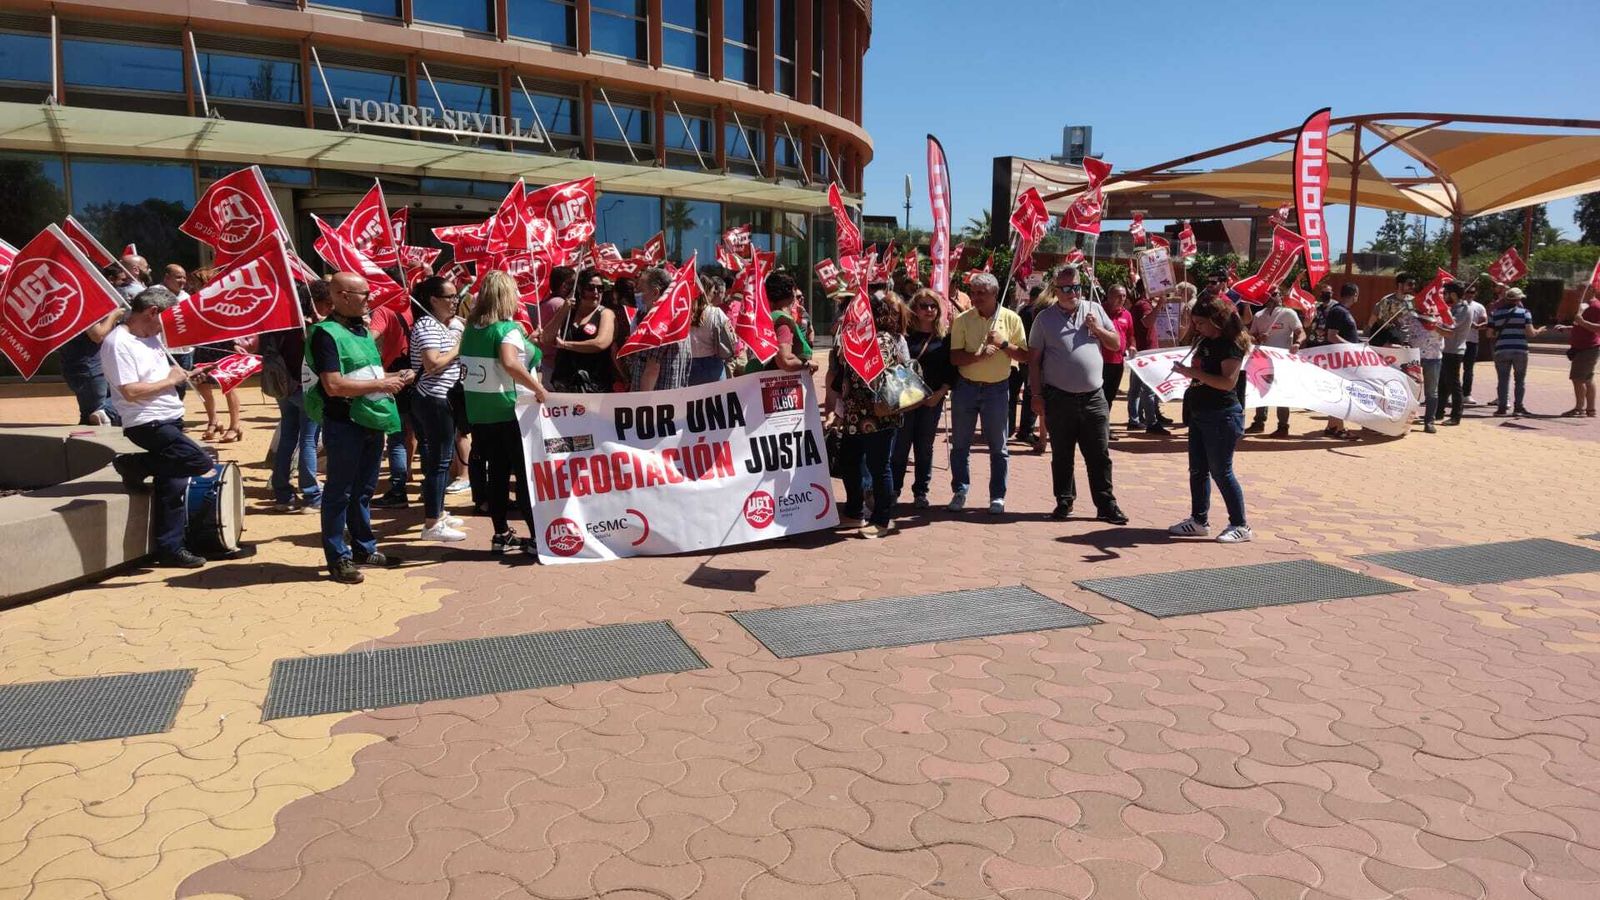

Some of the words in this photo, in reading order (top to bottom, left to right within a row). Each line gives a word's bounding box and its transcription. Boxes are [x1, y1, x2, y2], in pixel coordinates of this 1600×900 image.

[343, 98, 436, 129] TORRE
[440, 109, 543, 141] SEVILLA
[1301, 131, 1322, 236] CCOO
[551, 196, 586, 230] UGT
[464, 244, 487, 254] www
[1247, 240, 1285, 293] www.ugt.es
[6, 263, 62, 322] UGT
[542, 405, 569, 418] UGT
[614, 404, 676, 440] POR
[687, 391, 747, 433] UNA
[772, 394, 799, 411] ALGO?
[533, 436, 736, 501] NEGOCIACIÓN
[745, 430, 822, 474] JUSTA
[751, 496, 774, 508] UGT
[779, 491, 813, 507] FeSMC
[586, 518, 629, 534] FeSMC
